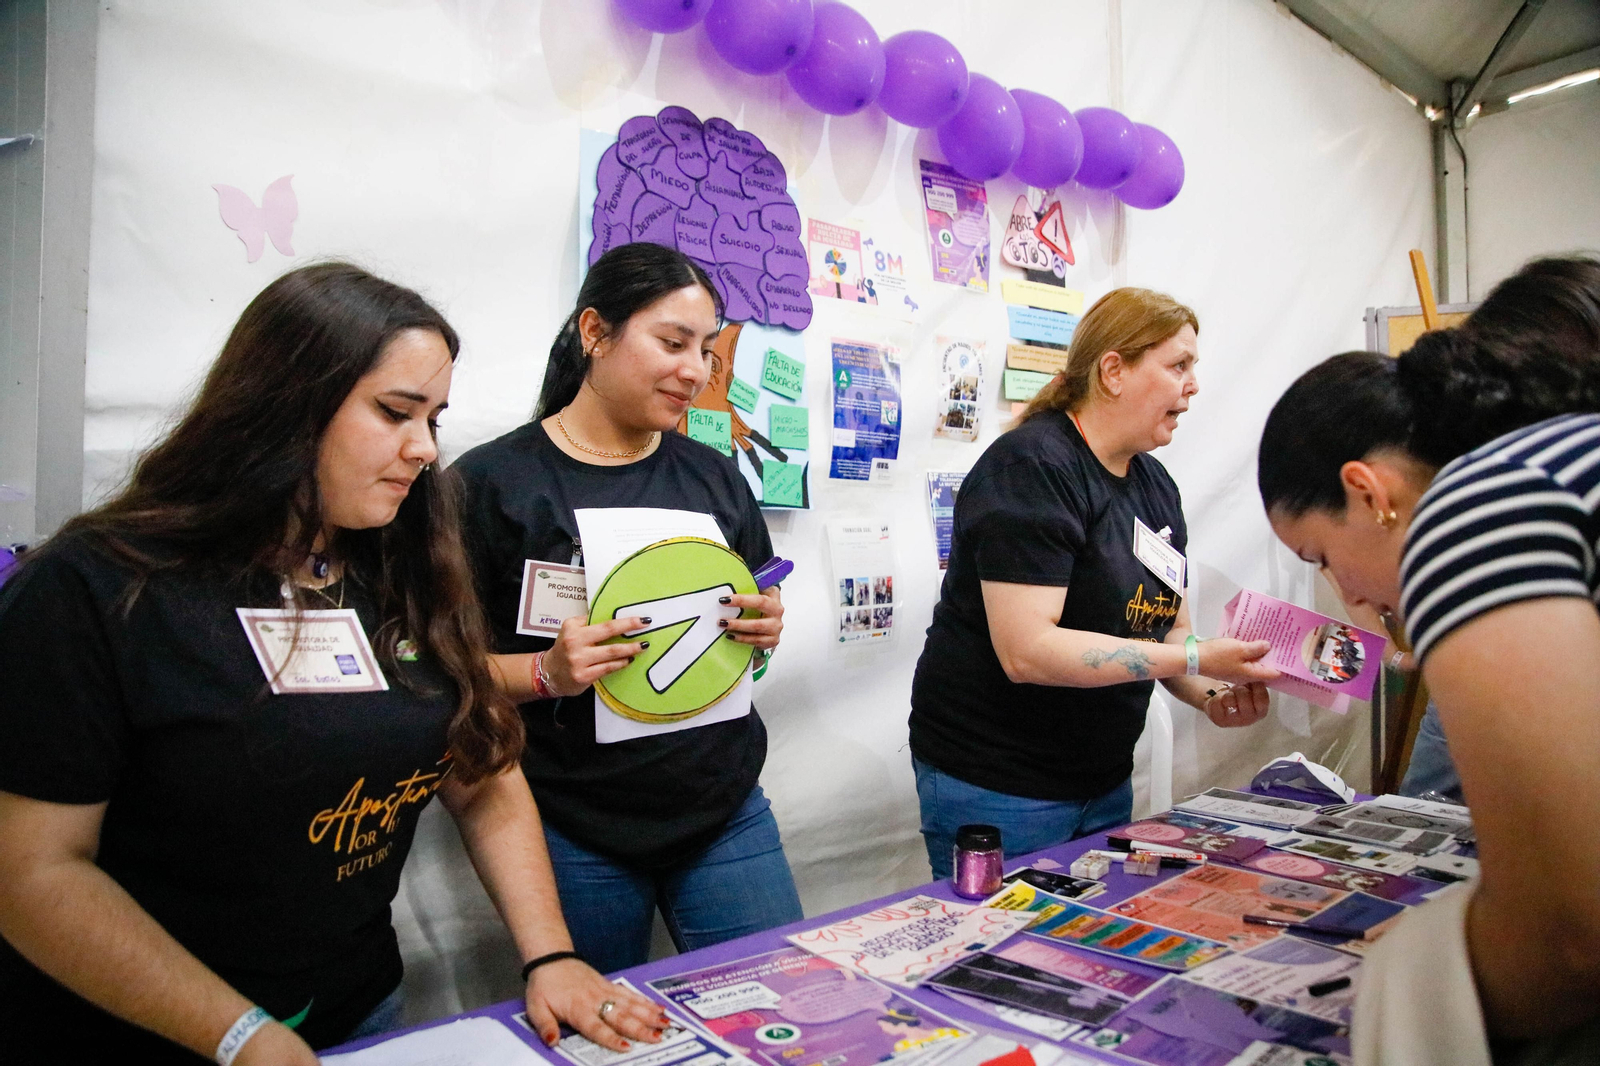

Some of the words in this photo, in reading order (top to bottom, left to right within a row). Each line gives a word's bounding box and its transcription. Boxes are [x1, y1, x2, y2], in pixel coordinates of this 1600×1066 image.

[622, 127, 656, 148] TRASTORNO
[680, 133, 690, 141] DE
[709, 122, 751, 146] PROBLEMAS
[625, 153, 638, 164] DEL
[642, 138, 662, 153] SUEÑO
[679, 151, 703, 160] CULPA
[650, 168, 690, 191] MIEDO
[753, 164, 775, 177] BAJA
[603, 168, 632, 214] FEMINICIDIO
[704, 180, 746, 201] AISLAMIENTO
[744, 177, 786, 196] AUTOESTIMA
[677, 212, 708, 230] LESIONES
[771, 220, 794, 232] ABUSO
[1010, 214, 1034, 232] ABRE
[719, 233, 761, 252] SUICIDIO
[774, 244, 803, 260] SEXUAL
[874, 250, 904, 276] 8M
[722, 268, 762, 318] MARGINALIDAD
[765, 282, 801, 298] EMBARAZO
[769, 301, 779, 310] NO
[782, 304, 812, 316] DESEADO
[768, 351, 790, 374] FALTA
[790, 366, 800, 376] DE
[765, 368, 802, 394] EDUCACIÓN
[688, 411, 713, 426] FALTA
[716, 422, 724, 433] DE
[548, 583, 586, 593] PROMOTOR
[556, 592, 587, 602] IGUALDA
[693, 985, 708, 994] DE
[708, 972, 758, 991] VIOLENCIA
[758, 970, 772, 978] DE
